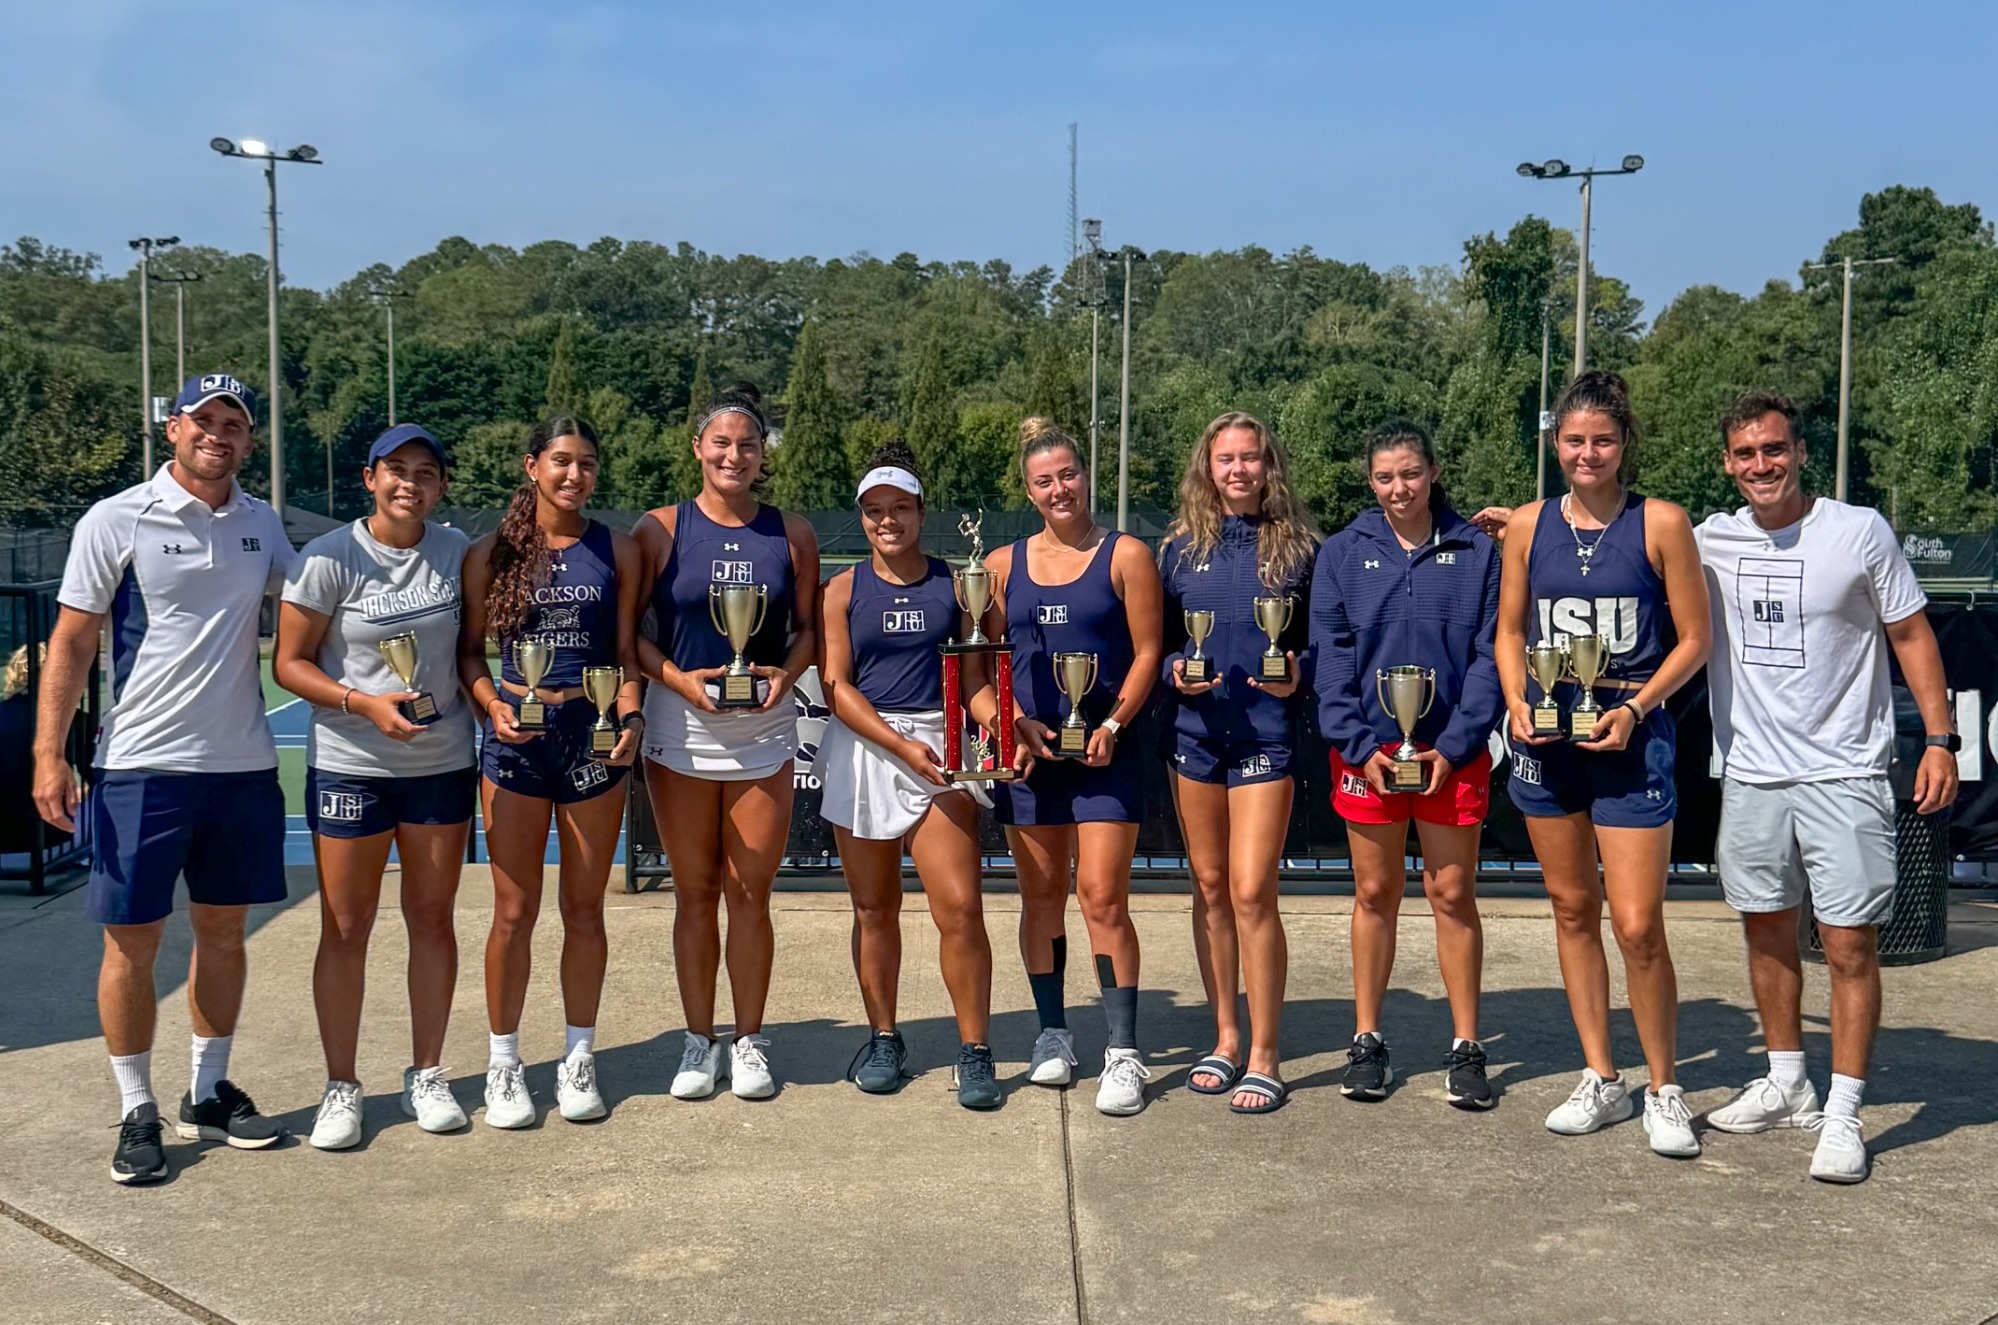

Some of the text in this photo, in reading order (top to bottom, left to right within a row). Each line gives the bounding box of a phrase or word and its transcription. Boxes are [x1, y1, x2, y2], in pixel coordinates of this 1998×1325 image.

[1903, 534, 1943, 558] South
[1917, 549, 1952, 560] Fulton
[712, 560, 754, 584] JSU
[361, 586, 429, 618] JACKSON
[524, 585, 602, 605] ACKSON
[883, 610, 926, 633] JSU
[1753, 600, 1784, 623] JSU
[1538, 597, 1639, 654] JSU
[319, 791, 362, 820] JSU
